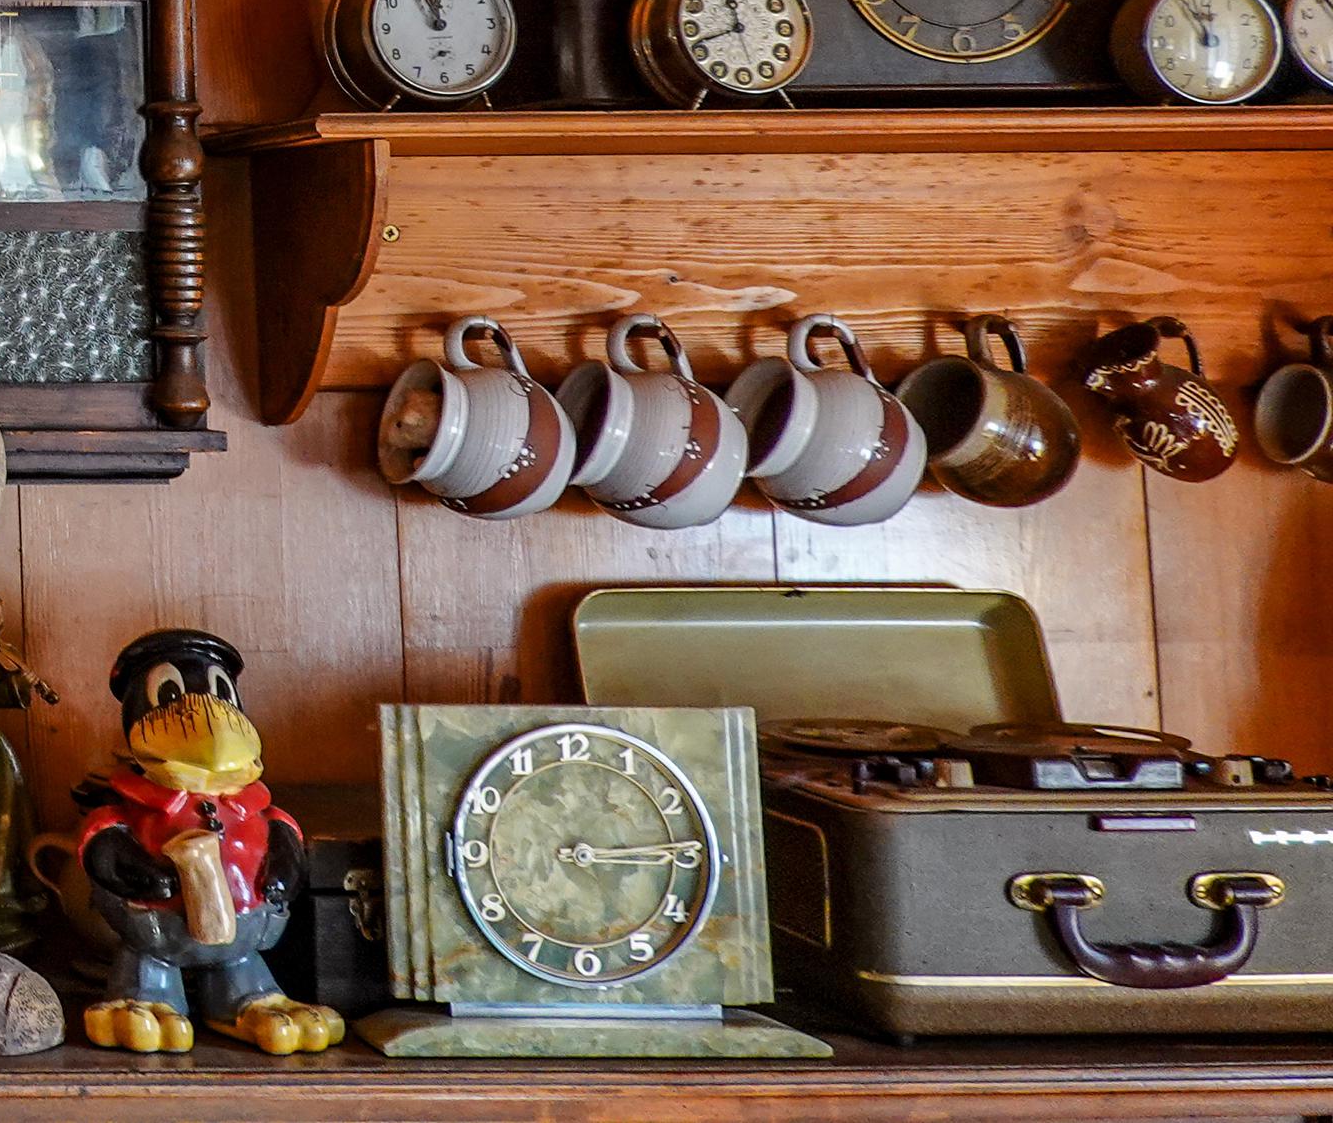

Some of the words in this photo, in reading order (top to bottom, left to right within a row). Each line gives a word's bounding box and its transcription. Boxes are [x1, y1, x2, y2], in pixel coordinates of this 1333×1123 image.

[392, 49, 401, 60] 8
[557, 733, 590, 762] 12
[508, 748, 533, 776] 11
[659, 787, 683, 814] 2
[481, 894, 506, 922] 8
[629, 933, 654, 962] 5
[574, 948, 602, 976] 6
